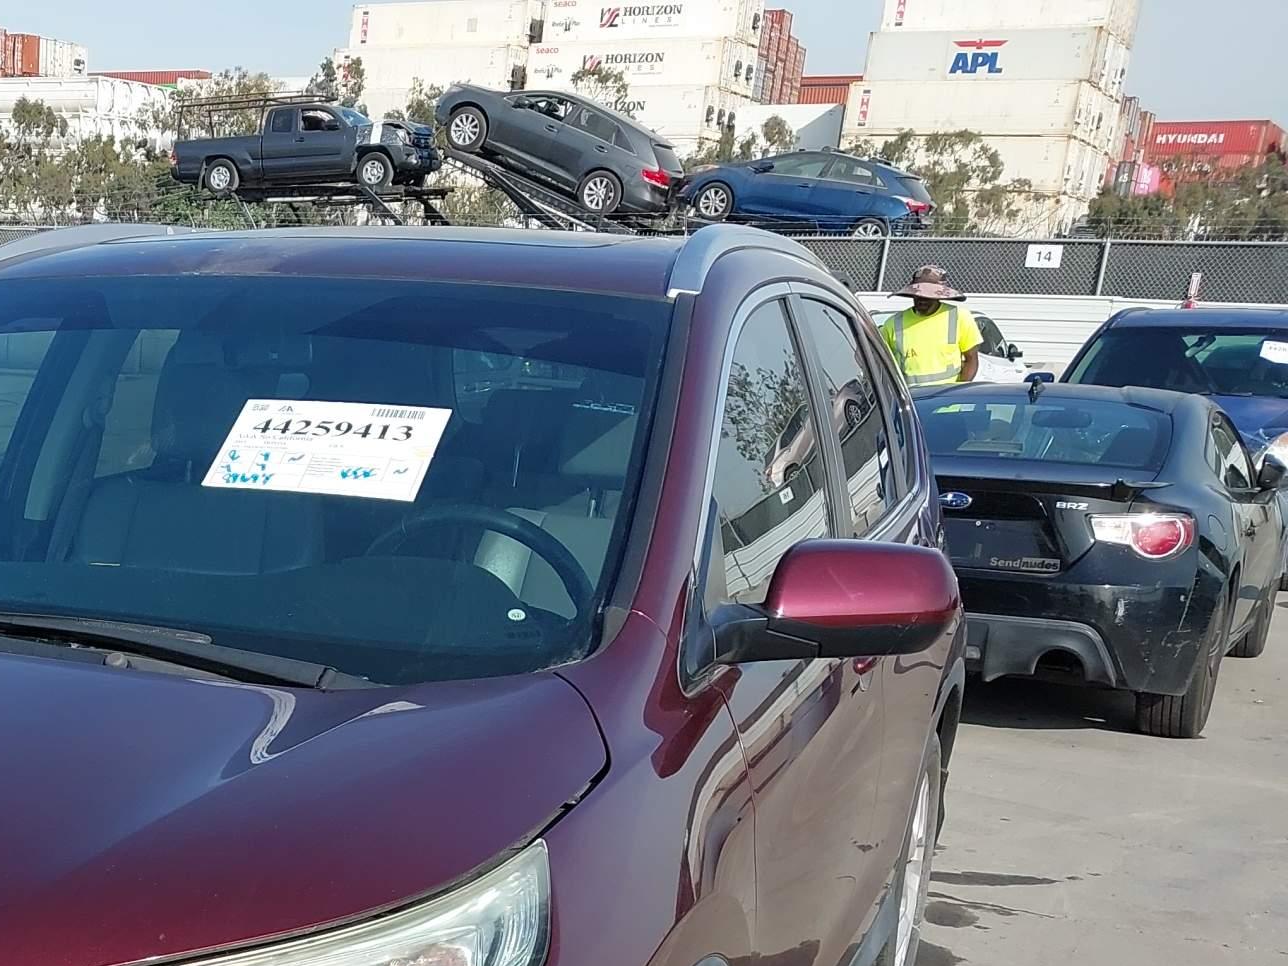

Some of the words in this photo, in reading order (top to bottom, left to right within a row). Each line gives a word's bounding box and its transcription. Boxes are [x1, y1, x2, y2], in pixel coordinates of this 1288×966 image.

[622, 4, 683, 16] HORIZON
[605, 52, 664, 64] HORIZON
[948, 51, 1004, 74] APL
[1155, 133, 1225, 144] HYUNDAI
[1036, 251, 1052, 262] 14
[252, 418, 414, 441] 44259413
[1056, 501, 1089, 511] BRZ
